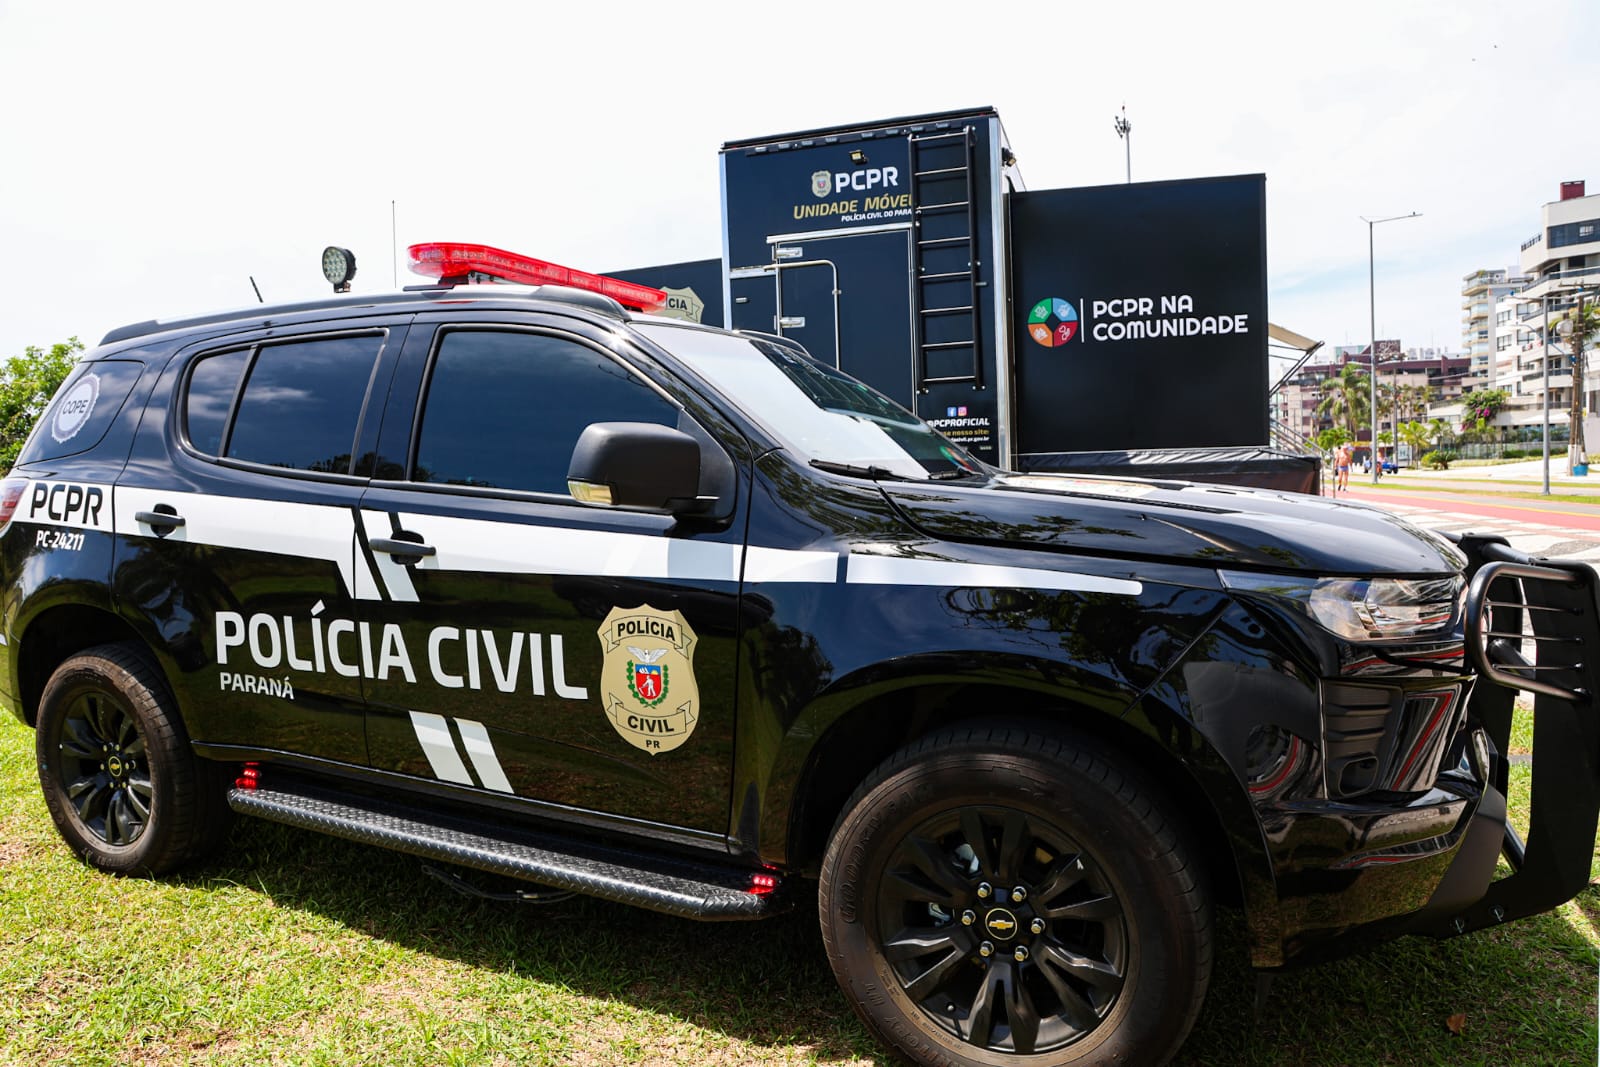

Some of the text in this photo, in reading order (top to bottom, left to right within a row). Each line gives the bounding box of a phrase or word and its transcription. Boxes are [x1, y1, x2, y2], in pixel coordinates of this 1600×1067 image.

[835, 166, 898, 193] PCPR
[793, 200, 859, 220] UNIDADE
[841, 212, 866, 223] POLÍCIA
[867, 211, 882, 220] CIVIL
[884, 210, 894, 218] DO
[1093, 294, 1193, 319] PCPR NA
[1093, 314, 1248, 342] COMUNIDADE
[62, 399, 89, 415] COPE
[30, 482, 104, 526] PCPR
[35, 529, 86, 552] PC-24211
[617, 617, 676, 642] POLÍCIA
[215, 600, 589, 700] POLÍCIA CIVIL
[220, 672, 295, 700] PARANÁ
[627, 715, 675, 733] CIVIL
[646, 739, 660, 749] PR
